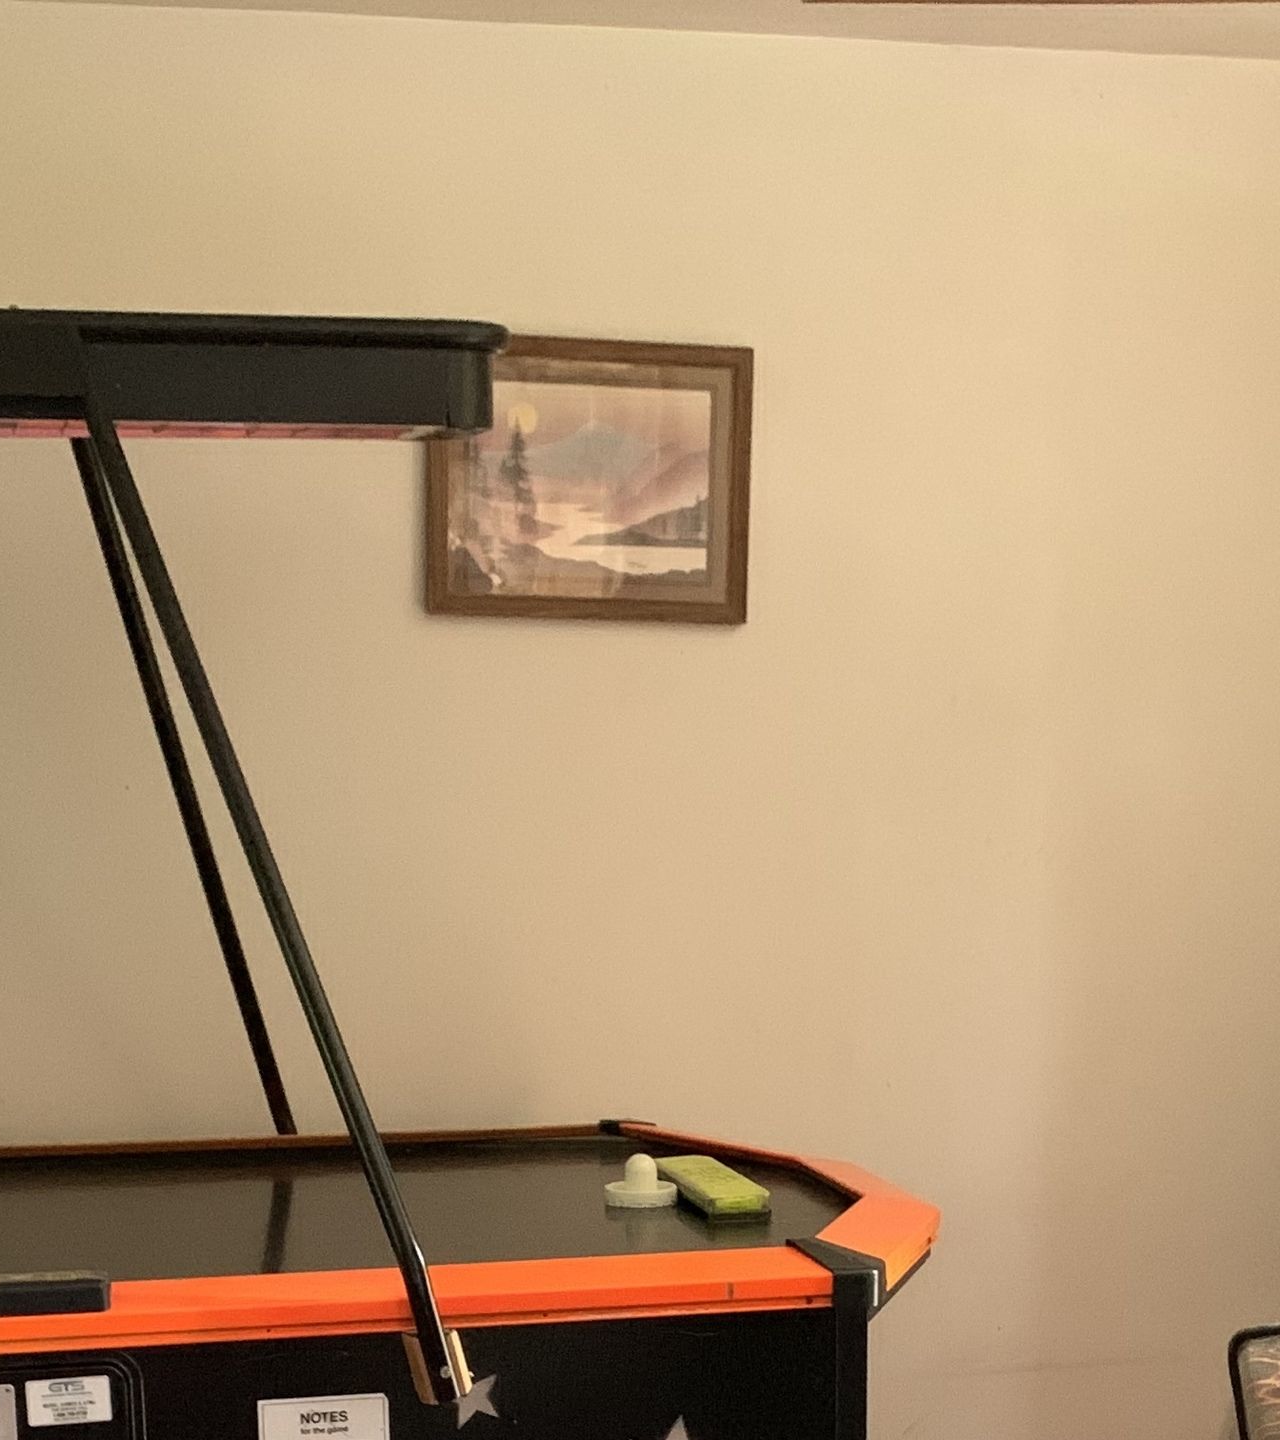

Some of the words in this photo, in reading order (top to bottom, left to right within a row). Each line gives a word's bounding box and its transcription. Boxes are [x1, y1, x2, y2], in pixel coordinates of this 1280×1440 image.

[48, 1381, 85, 1392] GTS
[300, 1410, 349, 1424] NOTES
[313, 1426, 325, 1434] the
[327, 1425, 349, 1434] game
